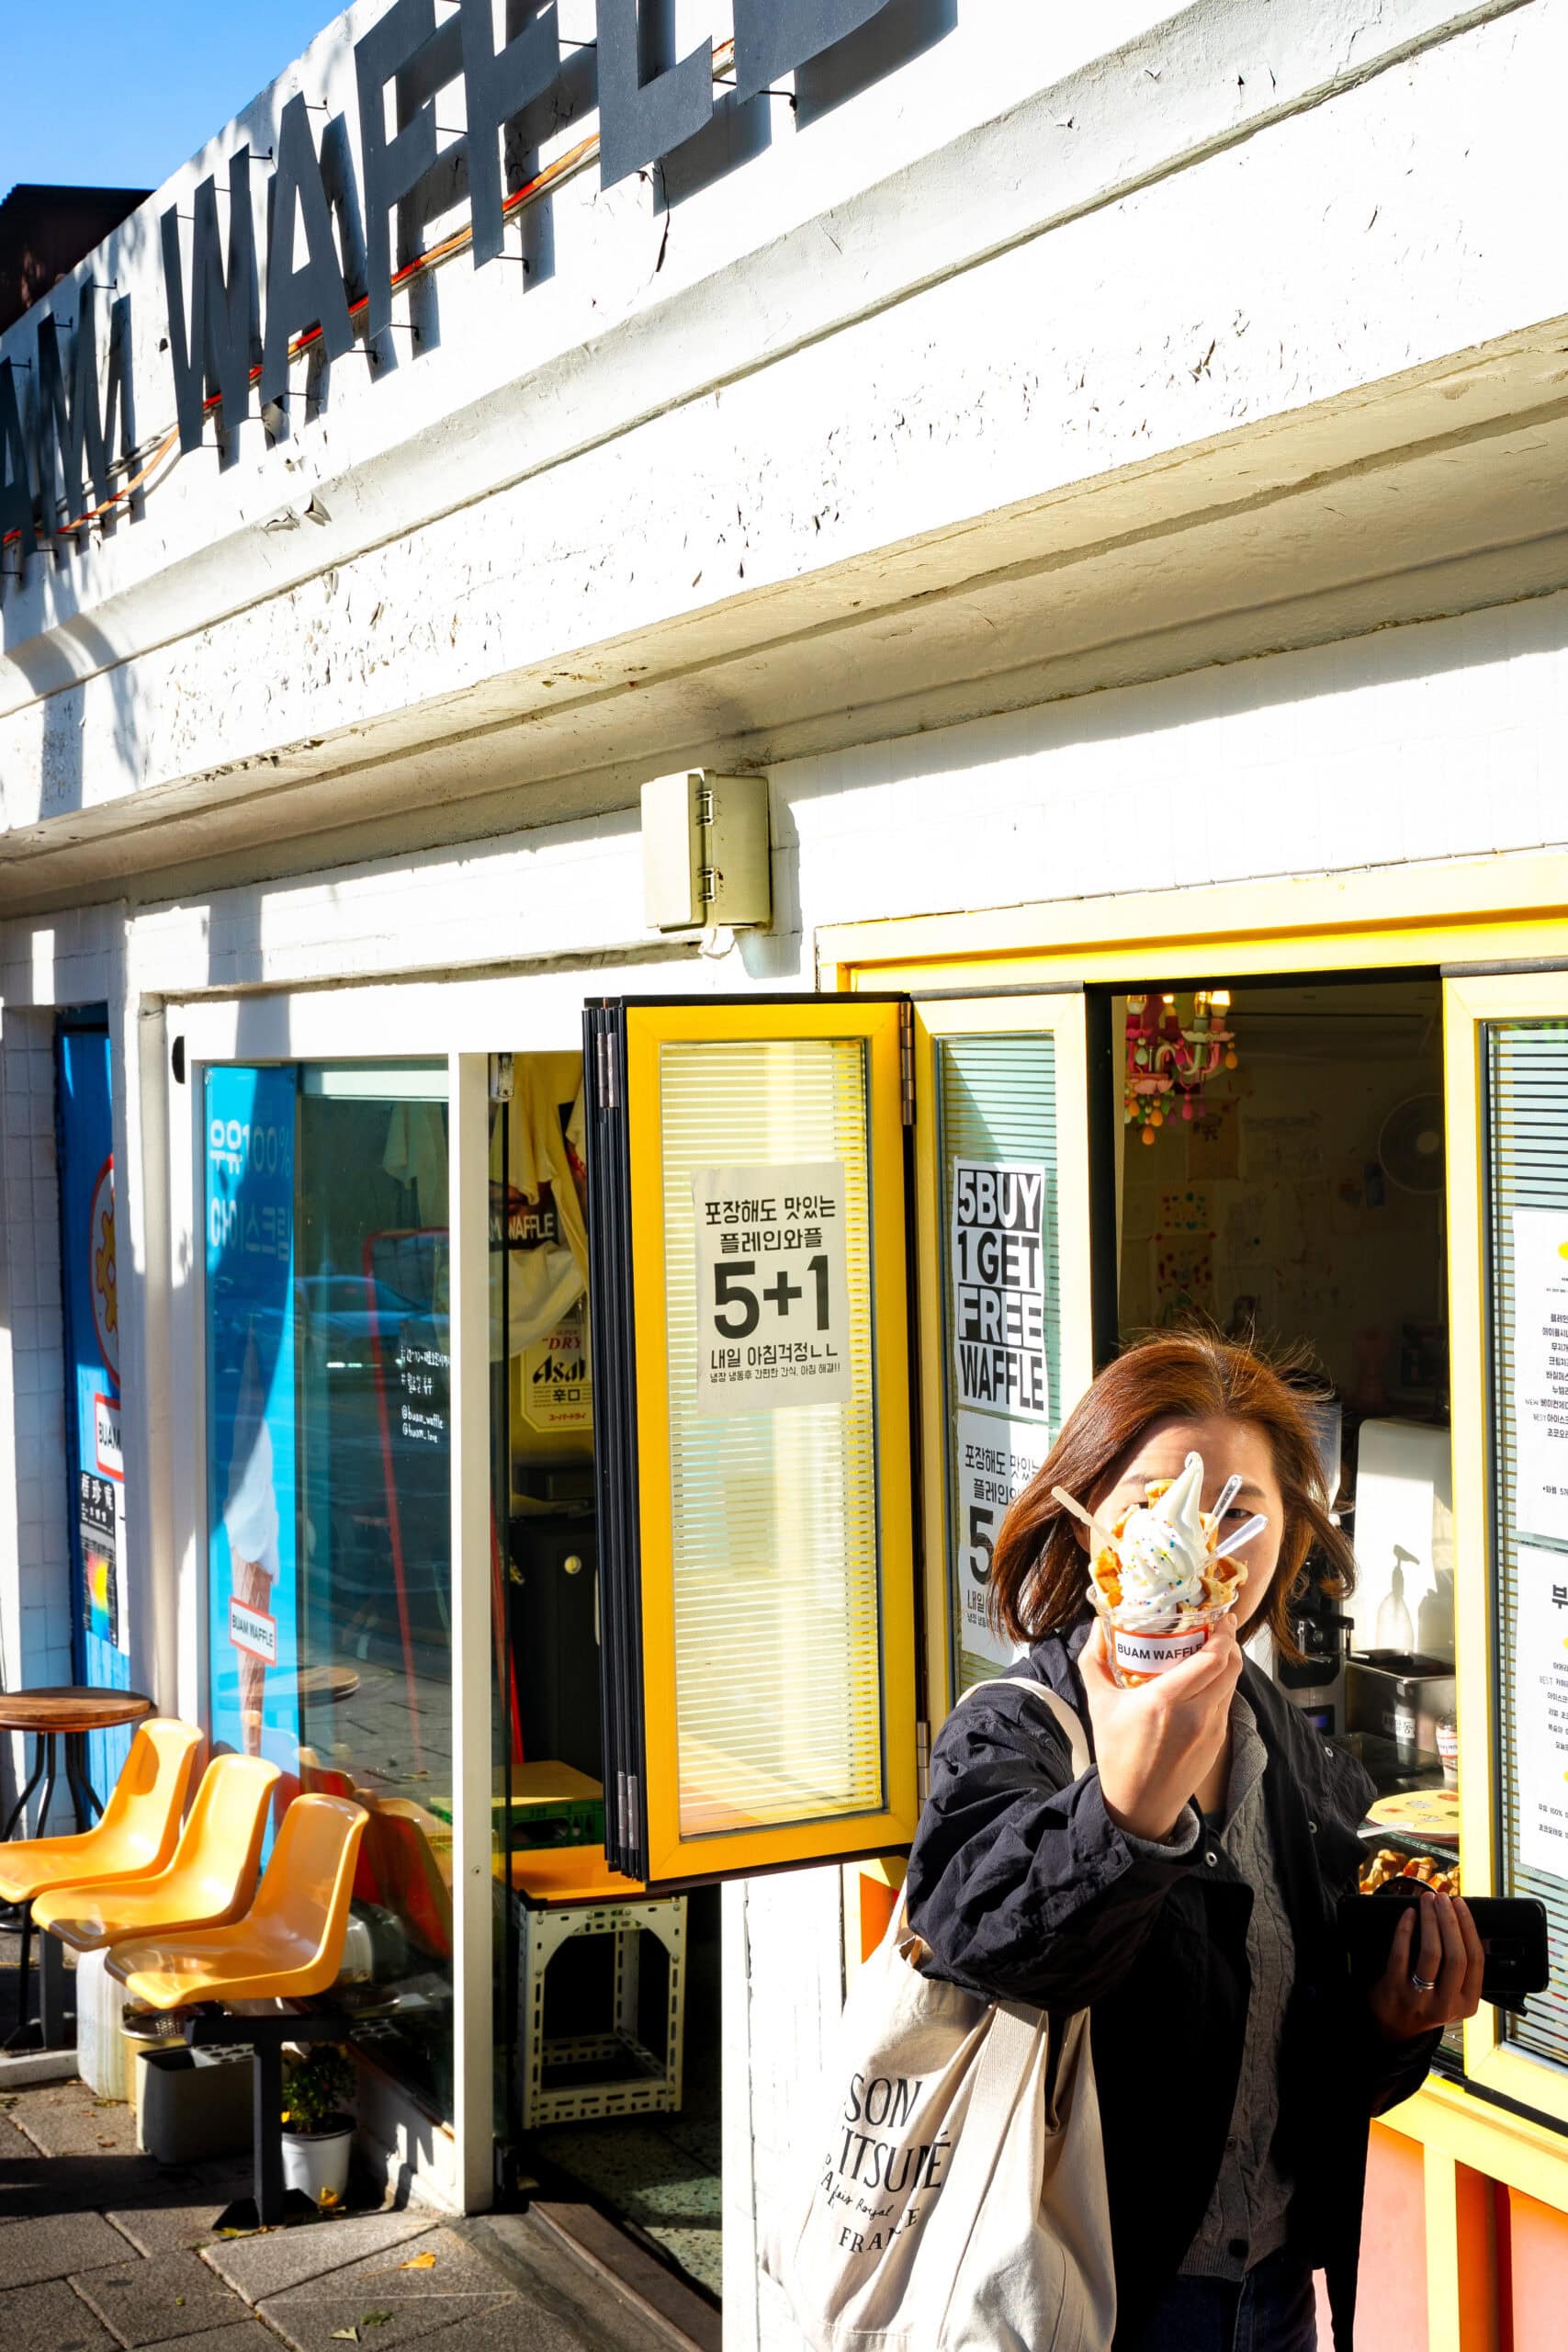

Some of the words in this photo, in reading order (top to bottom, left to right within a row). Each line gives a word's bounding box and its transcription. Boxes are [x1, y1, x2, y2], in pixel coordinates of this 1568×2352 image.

[705, 1199, 777, 1225] 포장해도
[784, 1195, 836, 1220] 맛있는
[720, 1227, 822, 1254] 플레인와플
[977, 1231, 1040, 1288] GET
[714, 1255, 829, 1340] 5+1
[958, 1286, 1042, 1349] FREE
[711, 1348, 740, 1369] 내일
[960, 1343, 1044, 1410] WAFFLE
[553, 1389, 581, 1402] 辛口
[964, 1444, 1006, 1476] 포장해도
[232, 1613, 249, 1634] BUAM
[250, 1623, 273, 1648] WAFFLE
[1117, 1644, 1150, 1659] BUAM
